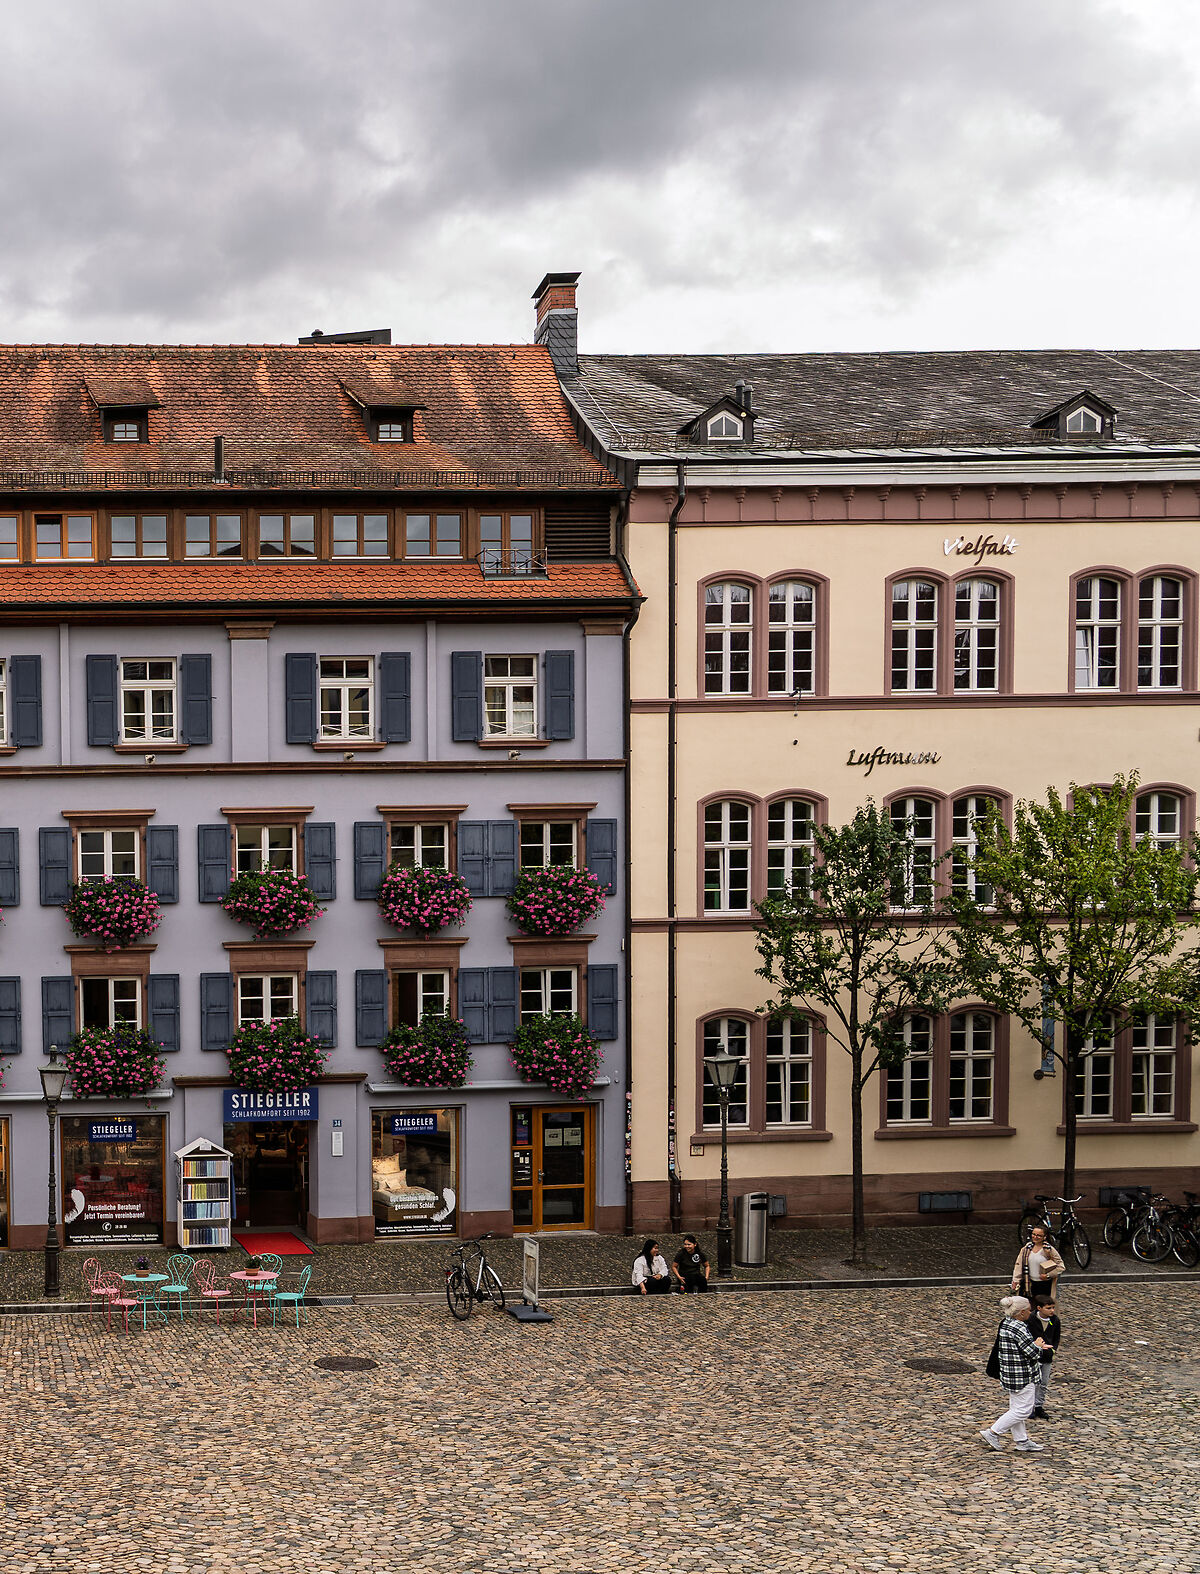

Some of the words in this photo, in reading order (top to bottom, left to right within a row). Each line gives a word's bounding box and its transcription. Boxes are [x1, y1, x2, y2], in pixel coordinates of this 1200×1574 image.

[944, 535, 1019, 566] Vielfalt
[231, 1092, 311, 1109] STIEGELER
[231, 1110, 281, 1118] SCHLAFKOMFORT
[283, 1109, 295, 1117] SEIT
[394, 1117, 434, 1127] STIEGELER
[92, 1125, 133, 1134] STIEGELER
[117, 1203, 141, 1211] Beratung!
[84, 1212, 96, 1220] Jetzt
[114, 1211, 145, 1219] vereinbaren!
